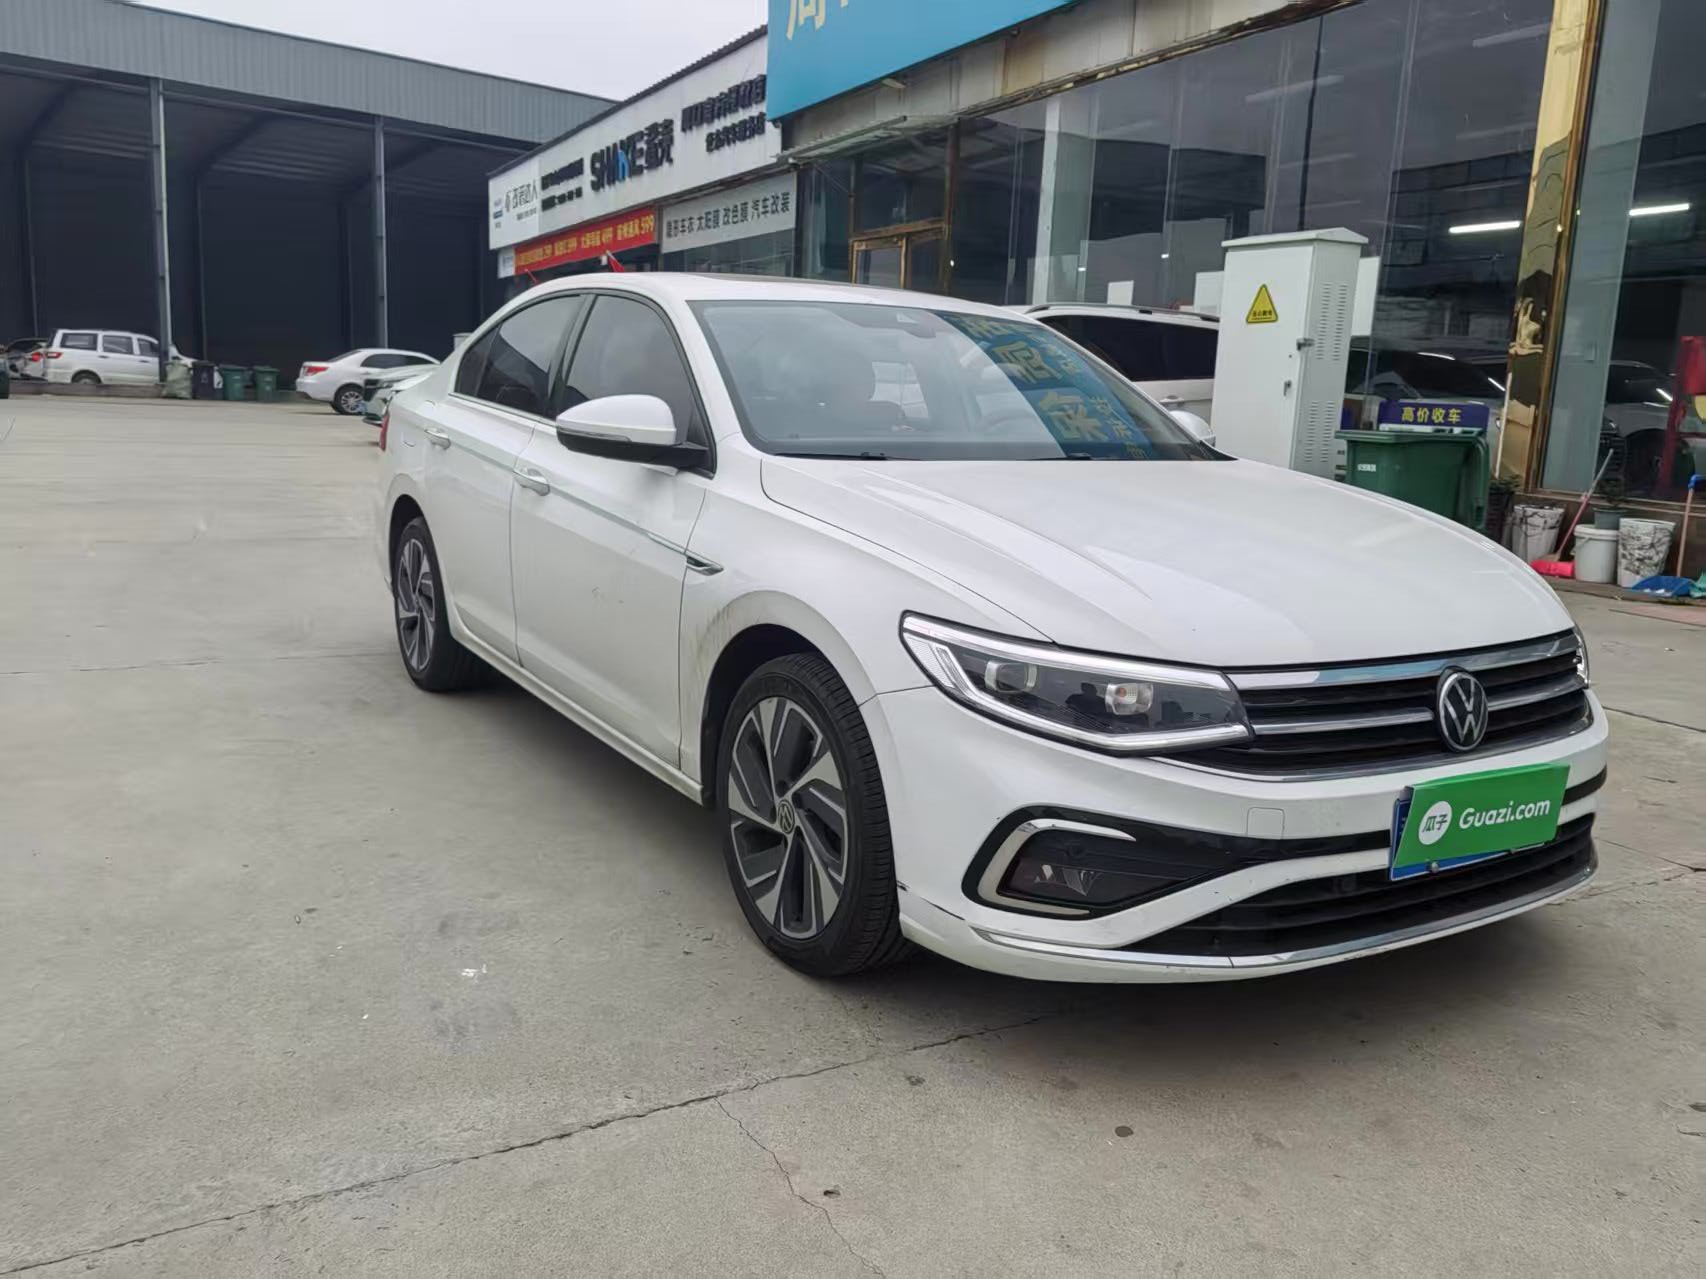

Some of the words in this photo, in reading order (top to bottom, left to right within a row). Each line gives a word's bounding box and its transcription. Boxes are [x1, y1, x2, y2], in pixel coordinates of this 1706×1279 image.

[722, 201, 749, 226] 改色膜
[751, 191, 790, 221] 汽车改装
[1401, 406, 1462, 424] 高价收车
[1421, 812, 1449, 834] 瓜子
[1459, 799, 1551, 830] Guazi.com
